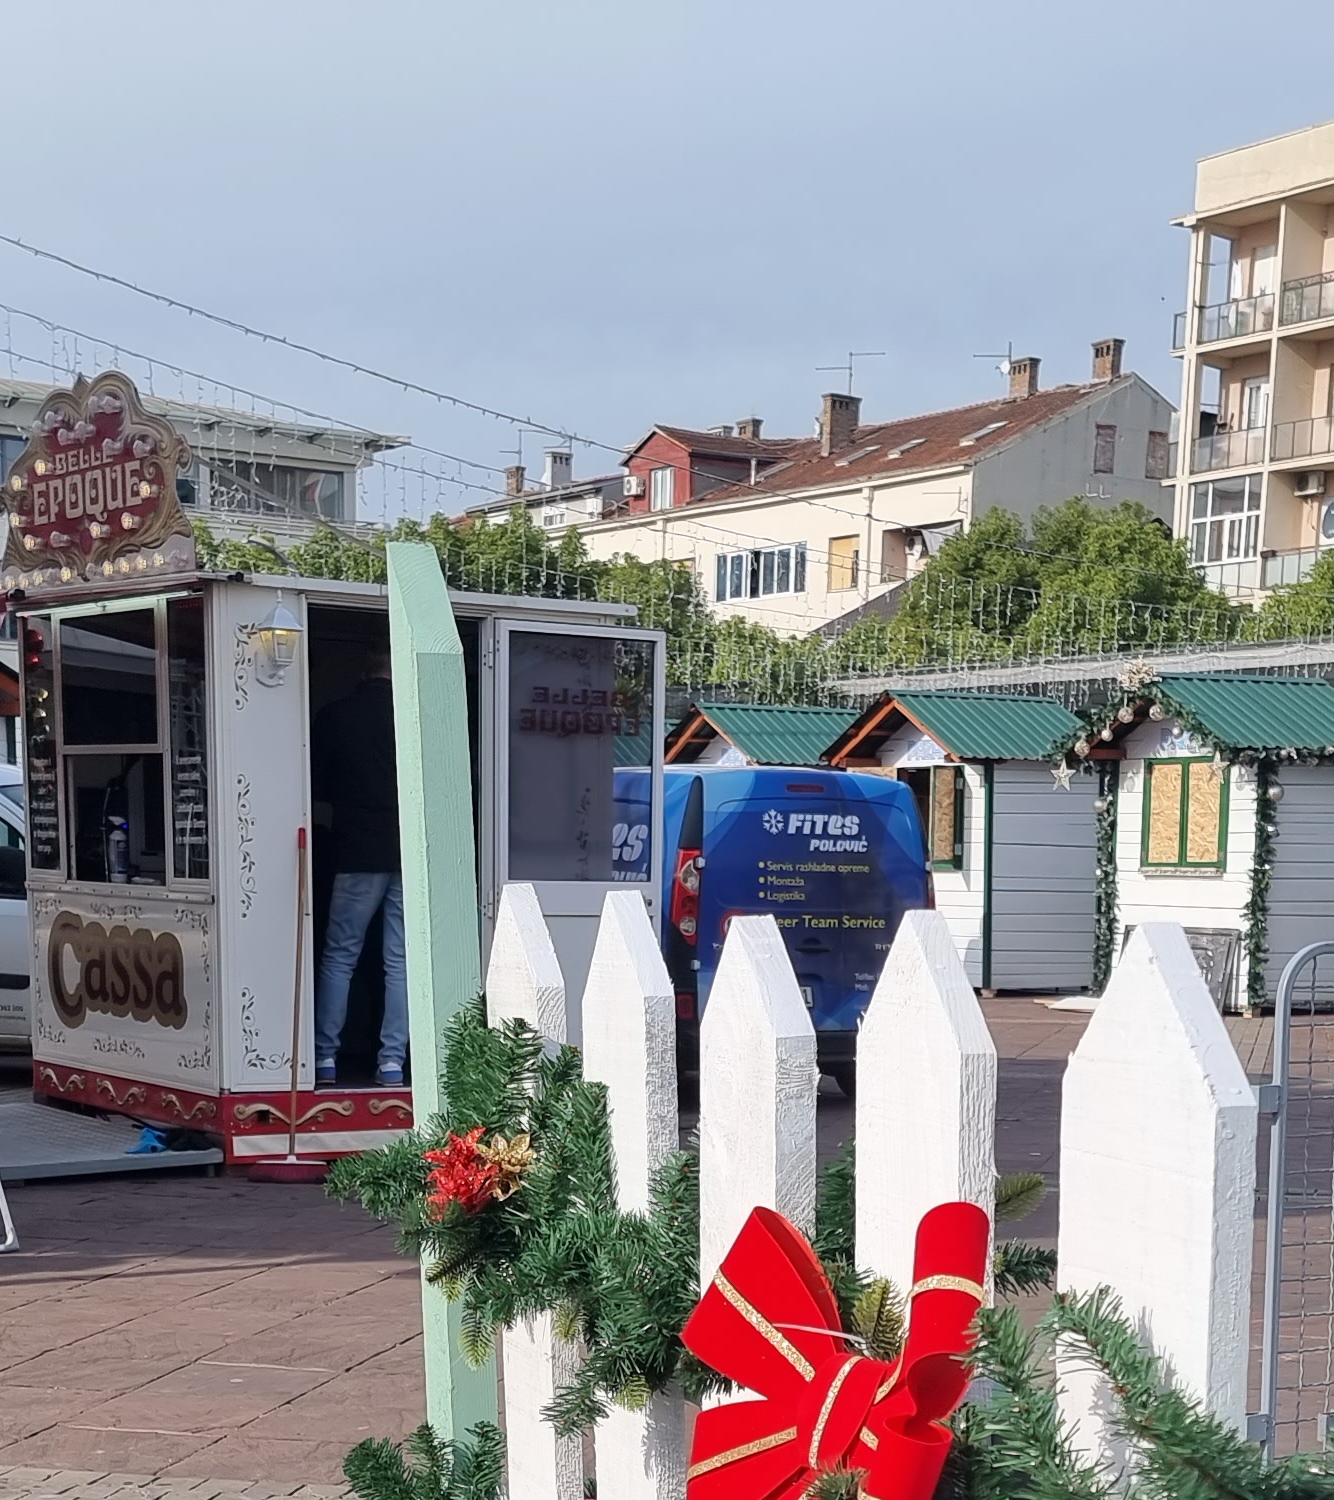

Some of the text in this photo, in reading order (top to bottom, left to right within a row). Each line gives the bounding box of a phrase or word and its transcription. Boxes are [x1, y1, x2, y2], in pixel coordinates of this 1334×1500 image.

[54, 445, 114, 475] BELLE
[33, 460, 142, 526] EPOQUE
[776, 915, 886, 928] eer Team Service
[49, 914, 186, 1026] Cassa
